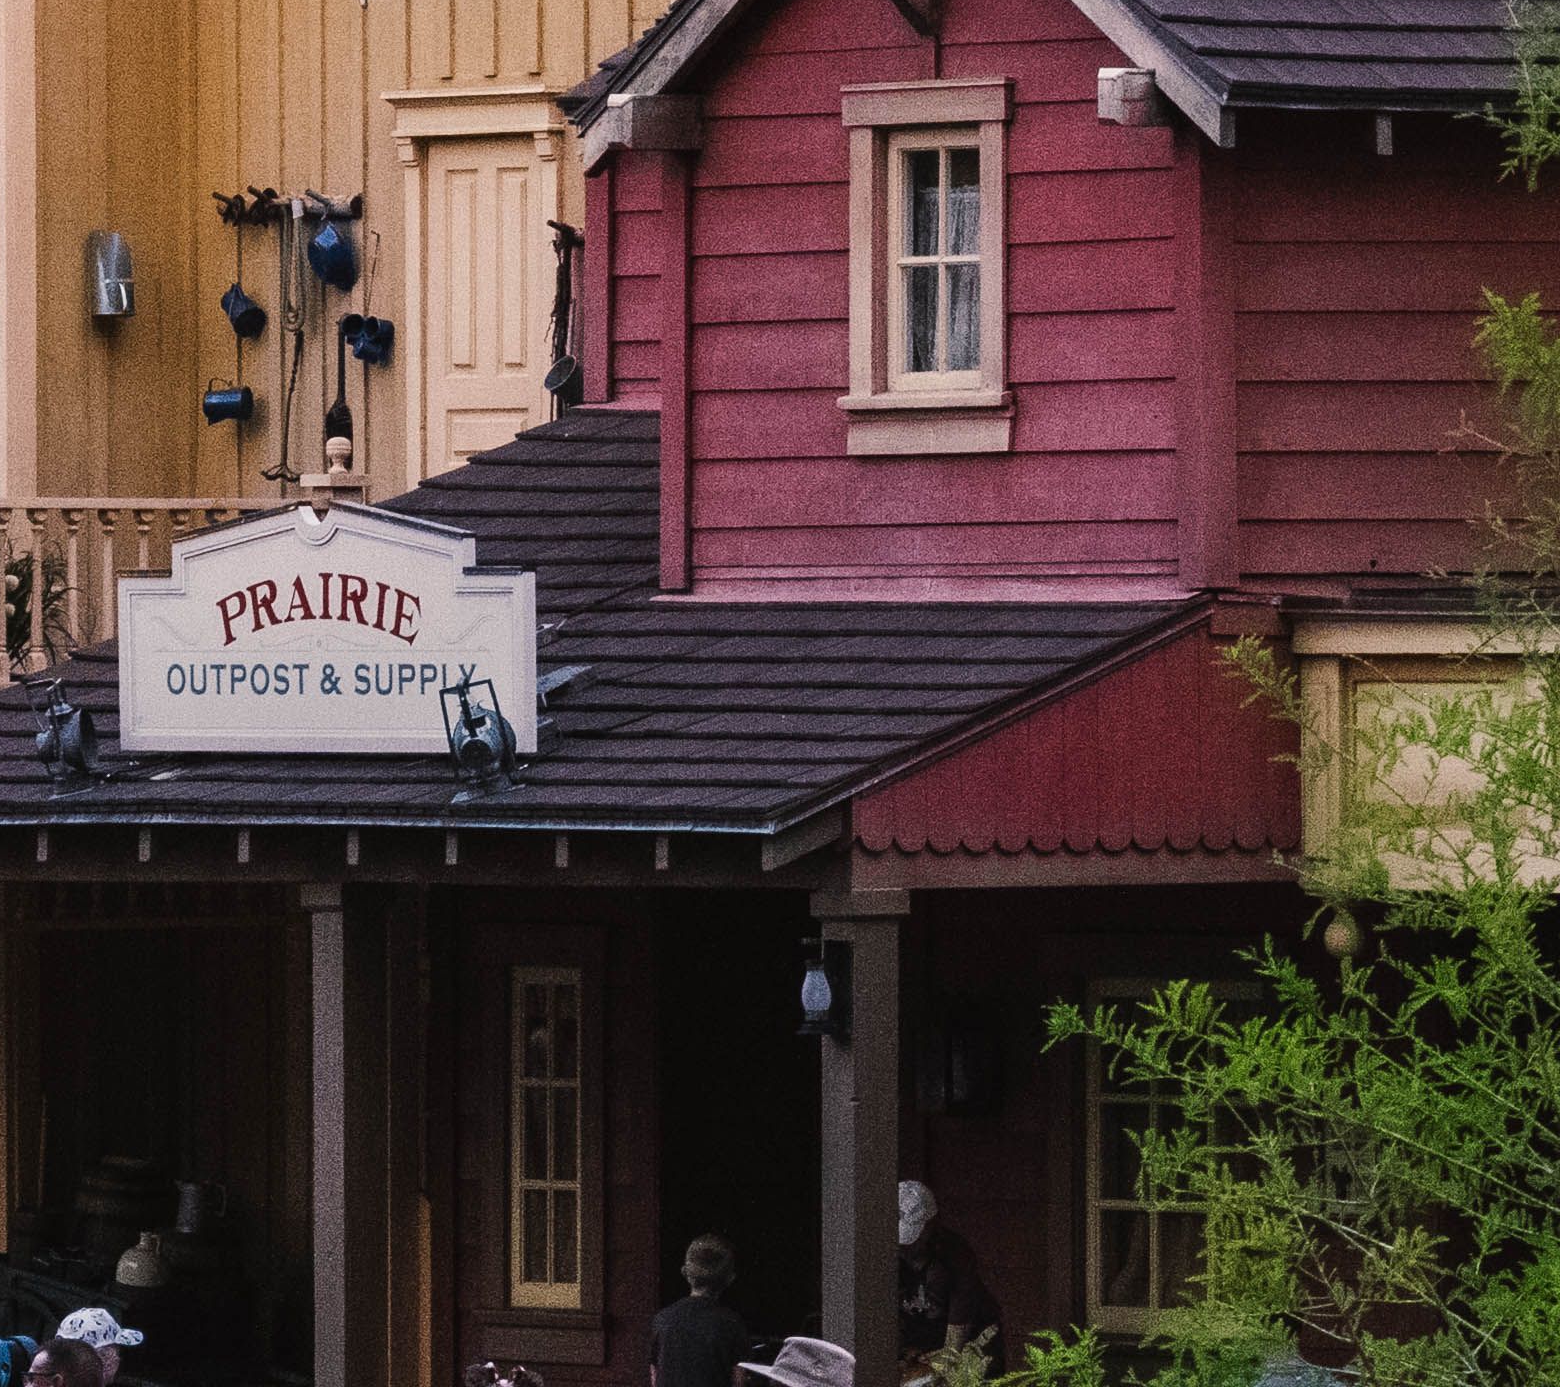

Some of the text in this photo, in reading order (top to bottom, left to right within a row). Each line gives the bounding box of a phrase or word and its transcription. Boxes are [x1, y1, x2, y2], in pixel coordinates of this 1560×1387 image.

[215, 572, 422, 647] PRAIRIE
[166, 662, 309, 696] OUTPOST
[319, 662, 342, 696] &
